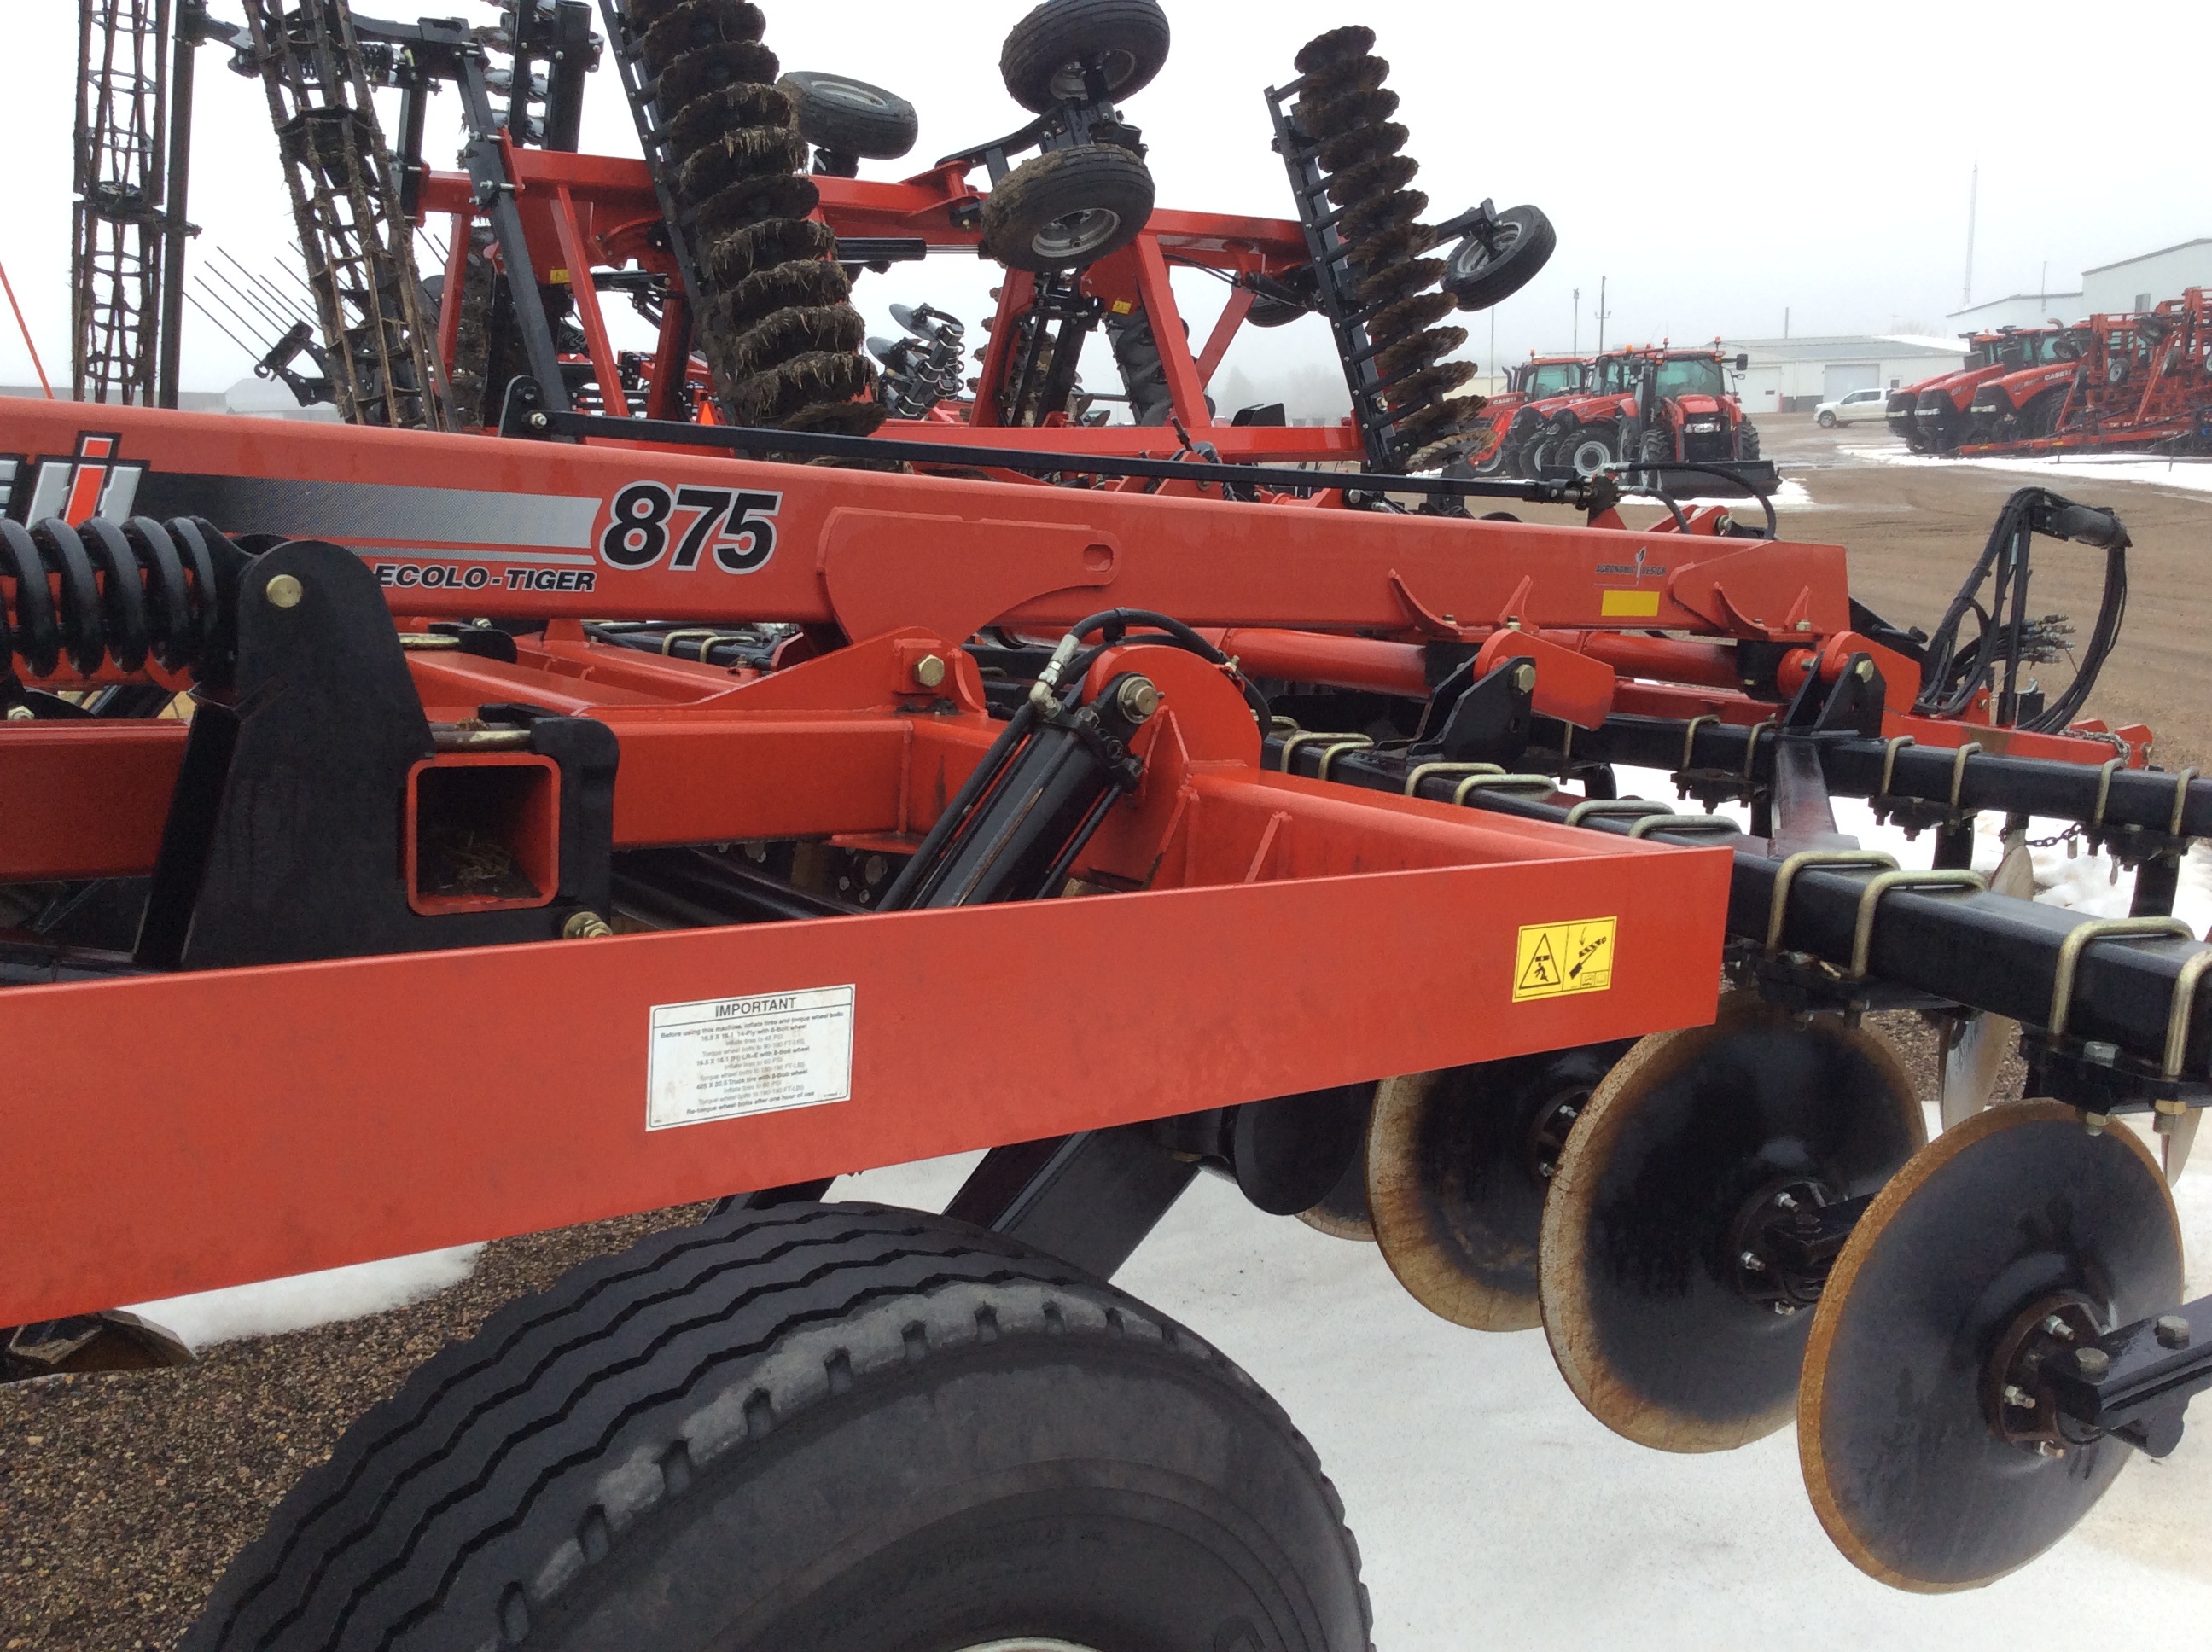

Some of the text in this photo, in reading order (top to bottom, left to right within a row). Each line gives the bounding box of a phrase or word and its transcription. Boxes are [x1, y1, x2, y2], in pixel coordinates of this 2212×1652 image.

[600, 480, 783, 575] 875
[1595, 564, 1667, 576] AGRONOMIC DESIGN
[715, 997, 797, 1018] IMPORTANT
